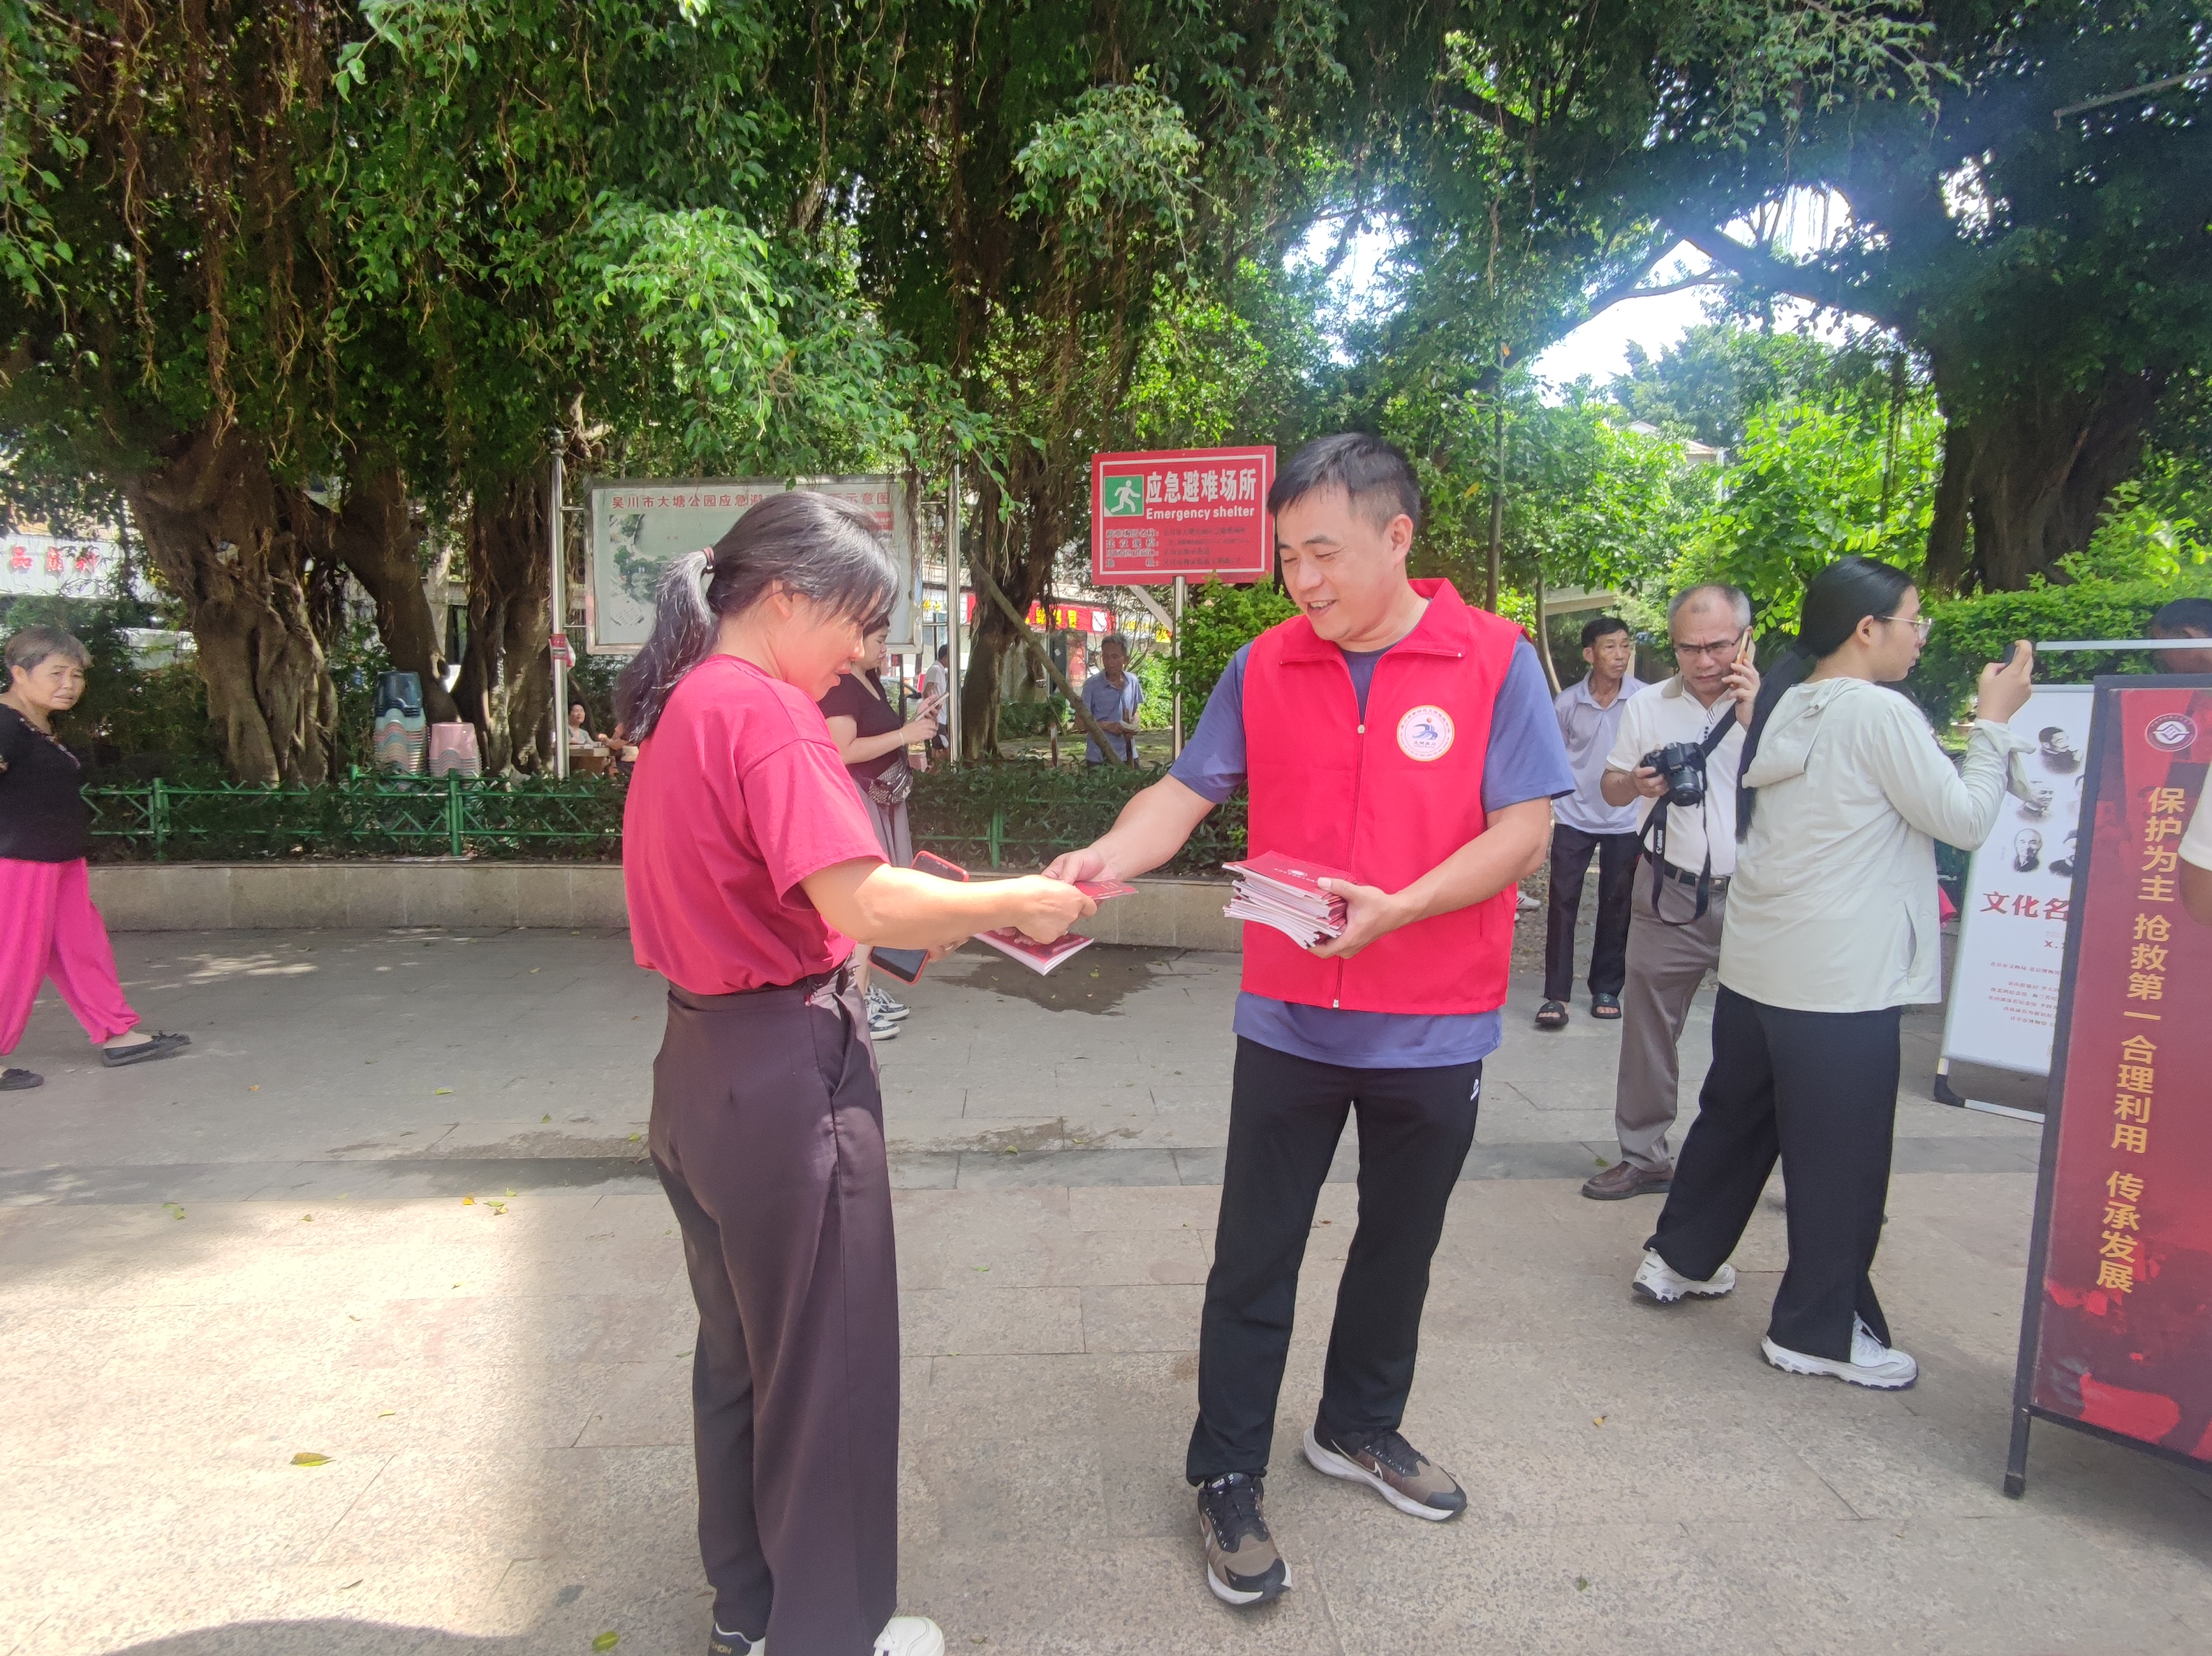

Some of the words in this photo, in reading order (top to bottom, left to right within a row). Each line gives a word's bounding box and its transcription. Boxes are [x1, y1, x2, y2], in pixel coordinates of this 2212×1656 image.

[1146, 469, 1256, 503] 应急避难场所
[1147, 508, 1211, 521] Emergency
[1213, 505, 1255, 517] shelter
[2138, 787, 2185, 902] 保护为主
[2123, 914, 2172, 1021] 抢救第一
[2111, 1035, 2158, 1154] 合理利用
[2096, 1171, 2144, 1293] 传承发展
